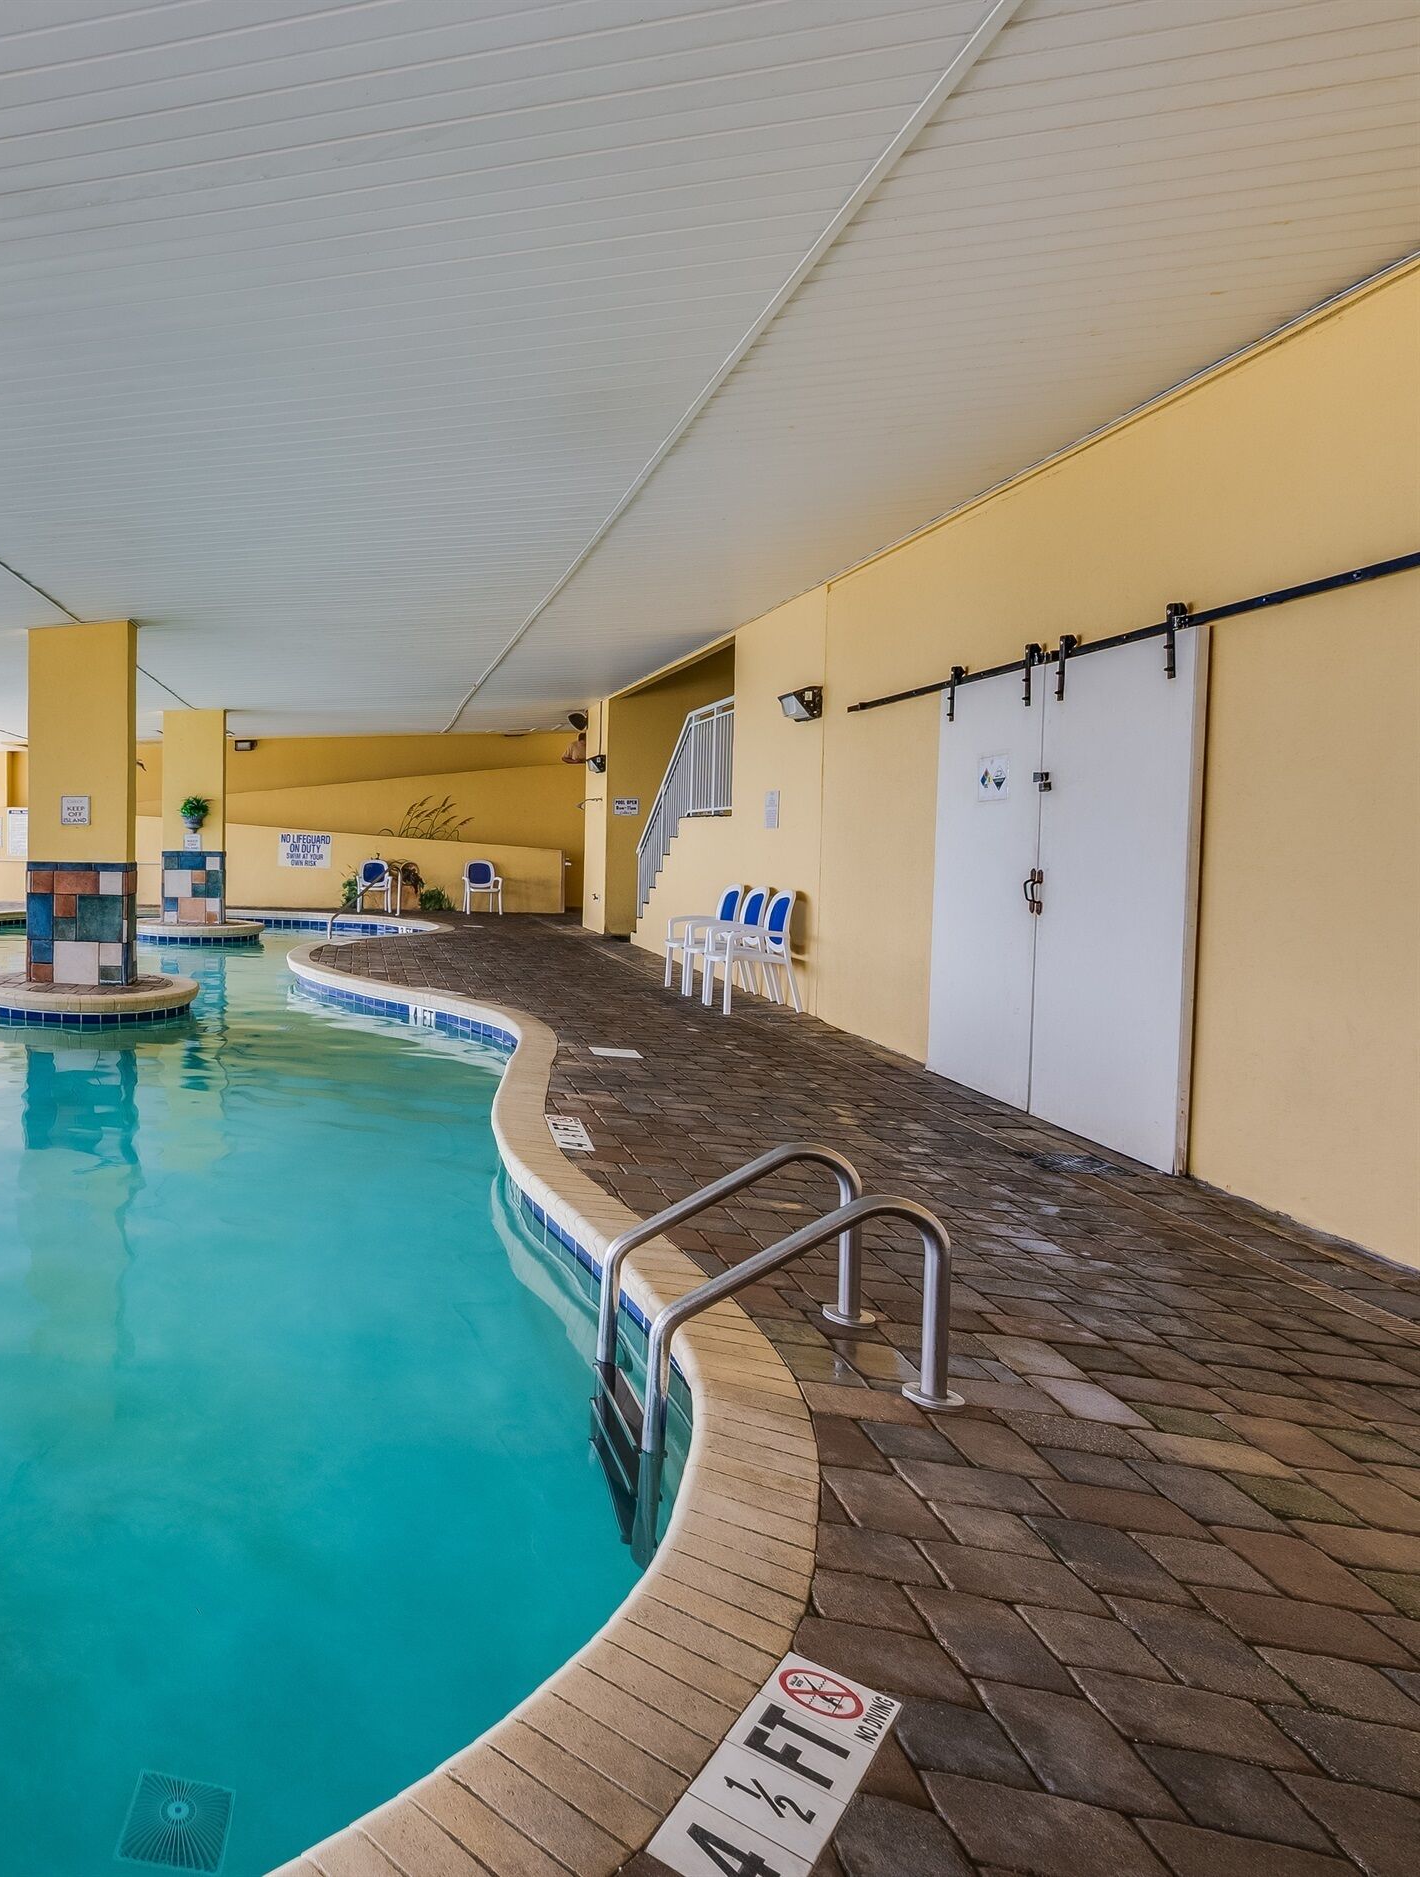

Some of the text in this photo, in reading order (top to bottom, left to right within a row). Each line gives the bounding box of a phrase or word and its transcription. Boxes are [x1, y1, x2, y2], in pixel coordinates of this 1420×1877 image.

[280, 834, 331, 844] NO LIFEGUARD
[289, 843, 321, 853] ON DUTY
[310, 853, 324, 861] YOUR
[854, 1696, 896, 1745] NO DIVING
[686, 1822, 781, 1877] 4
[743, 1703, 851, 1791] FT
